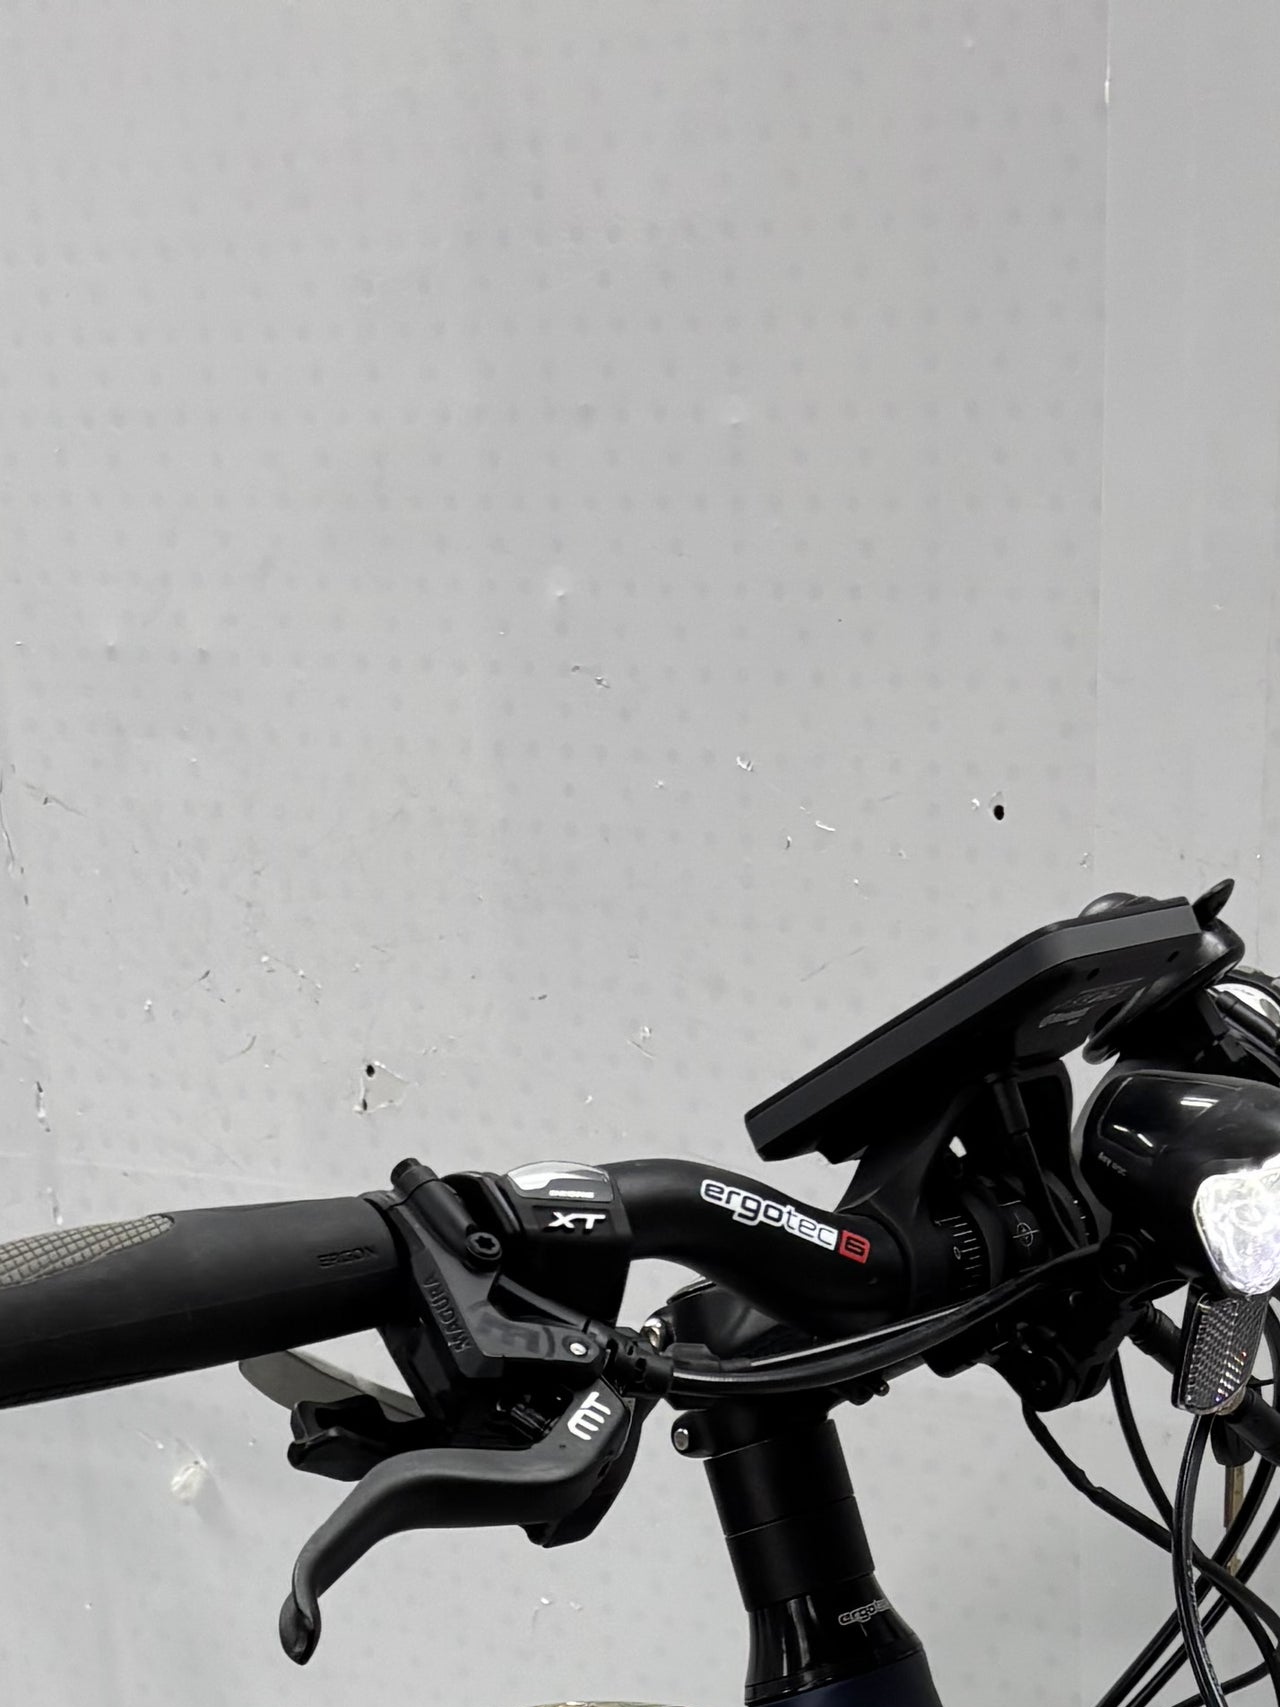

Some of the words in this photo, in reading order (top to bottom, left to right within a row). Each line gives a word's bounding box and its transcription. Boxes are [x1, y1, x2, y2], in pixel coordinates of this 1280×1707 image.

[547, 1211, 607, 1230] XT
[701, 1180, 837, 1250] ergotec
[423, 1271, 473, 1353] MAGURA
